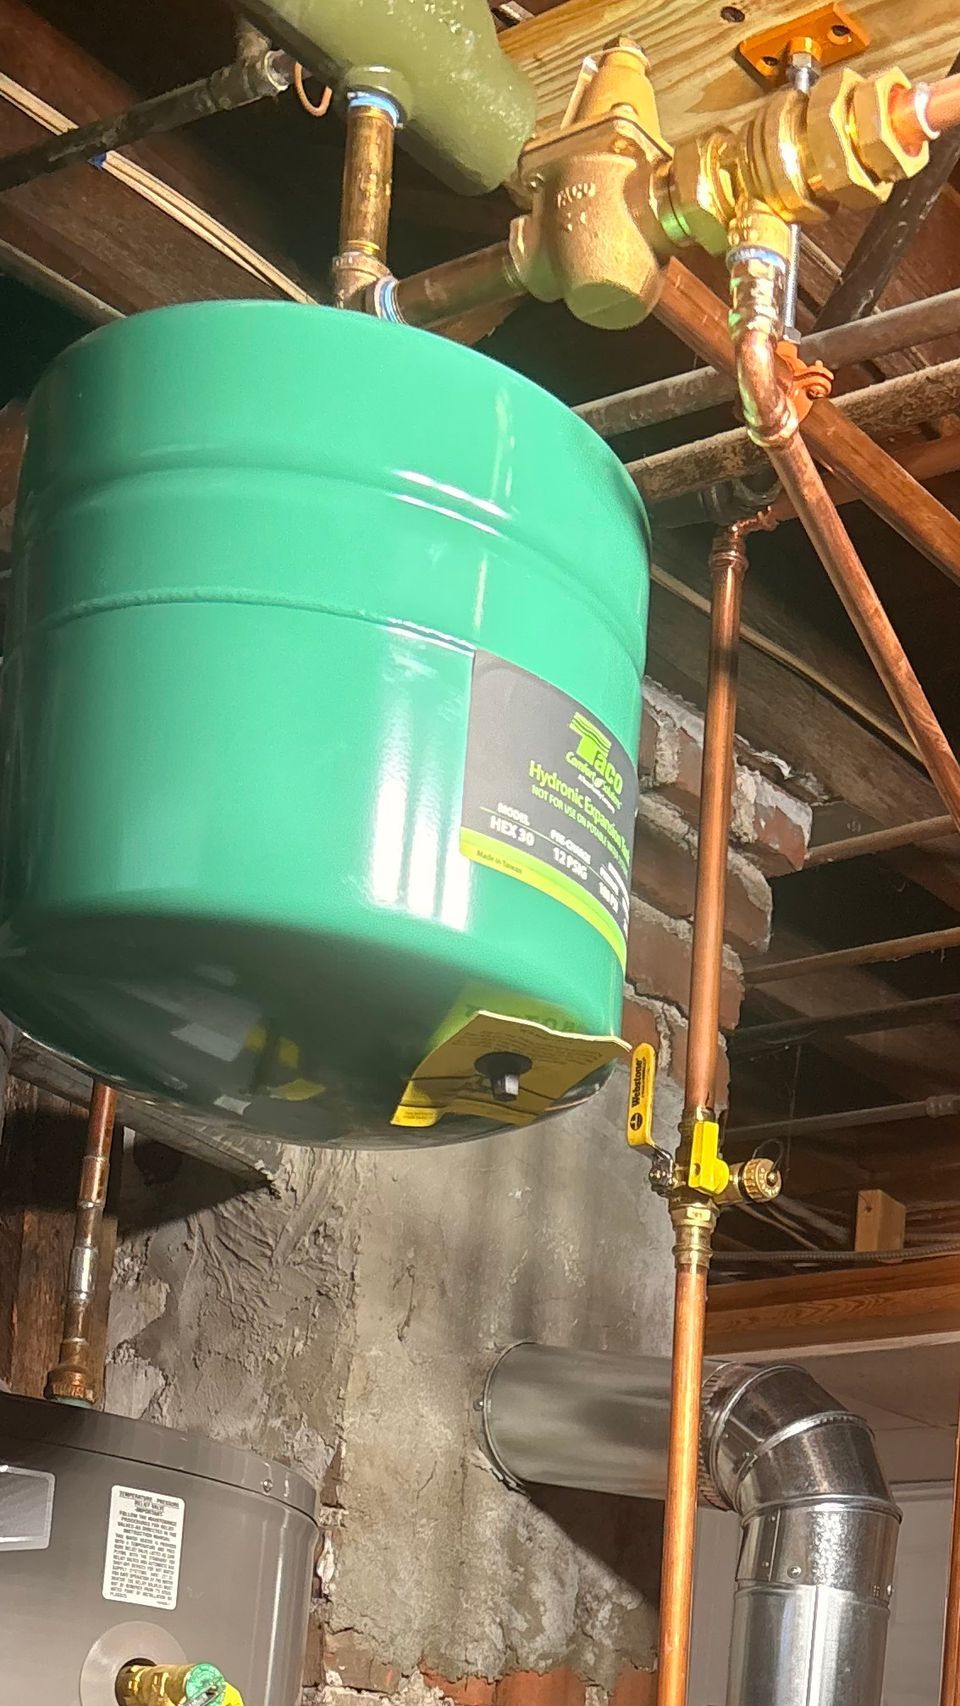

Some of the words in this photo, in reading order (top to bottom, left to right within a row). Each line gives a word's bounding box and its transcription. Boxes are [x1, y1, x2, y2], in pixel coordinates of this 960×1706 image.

[569, 712, 623, 795] Taco
[529, 759, 584, 808] Hydronic
[489, 815, 517, 839] HEX
[517, 825, 535, 846] 30
[497, 802, 530, 826] MODEL
[553, 847, 566, 866] 12
[566, 854, 588, 881] PSIG
[631, 1057, 644, 1107] Webstone
